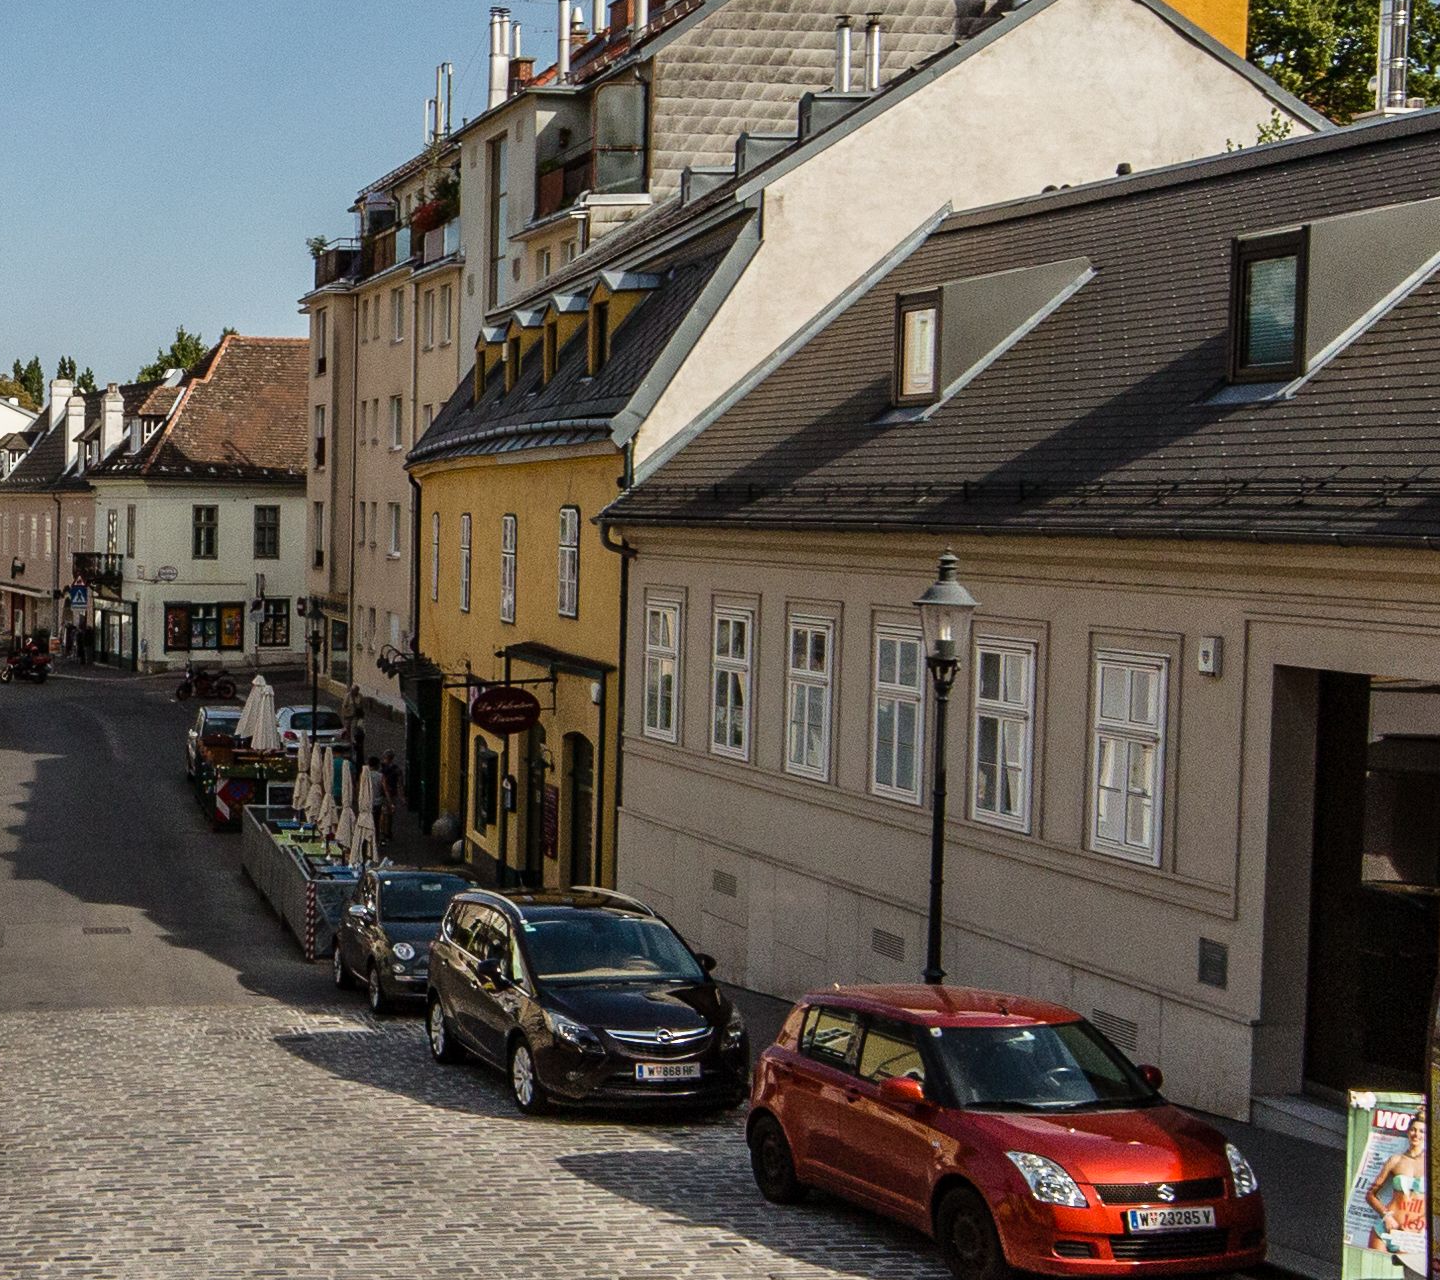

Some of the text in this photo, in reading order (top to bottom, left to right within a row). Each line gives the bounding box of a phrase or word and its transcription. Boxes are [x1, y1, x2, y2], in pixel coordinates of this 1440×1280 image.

[1376, 1109, 1416, 1131] WO
[1139, 1210, 1211, 1227] W 23285 V
